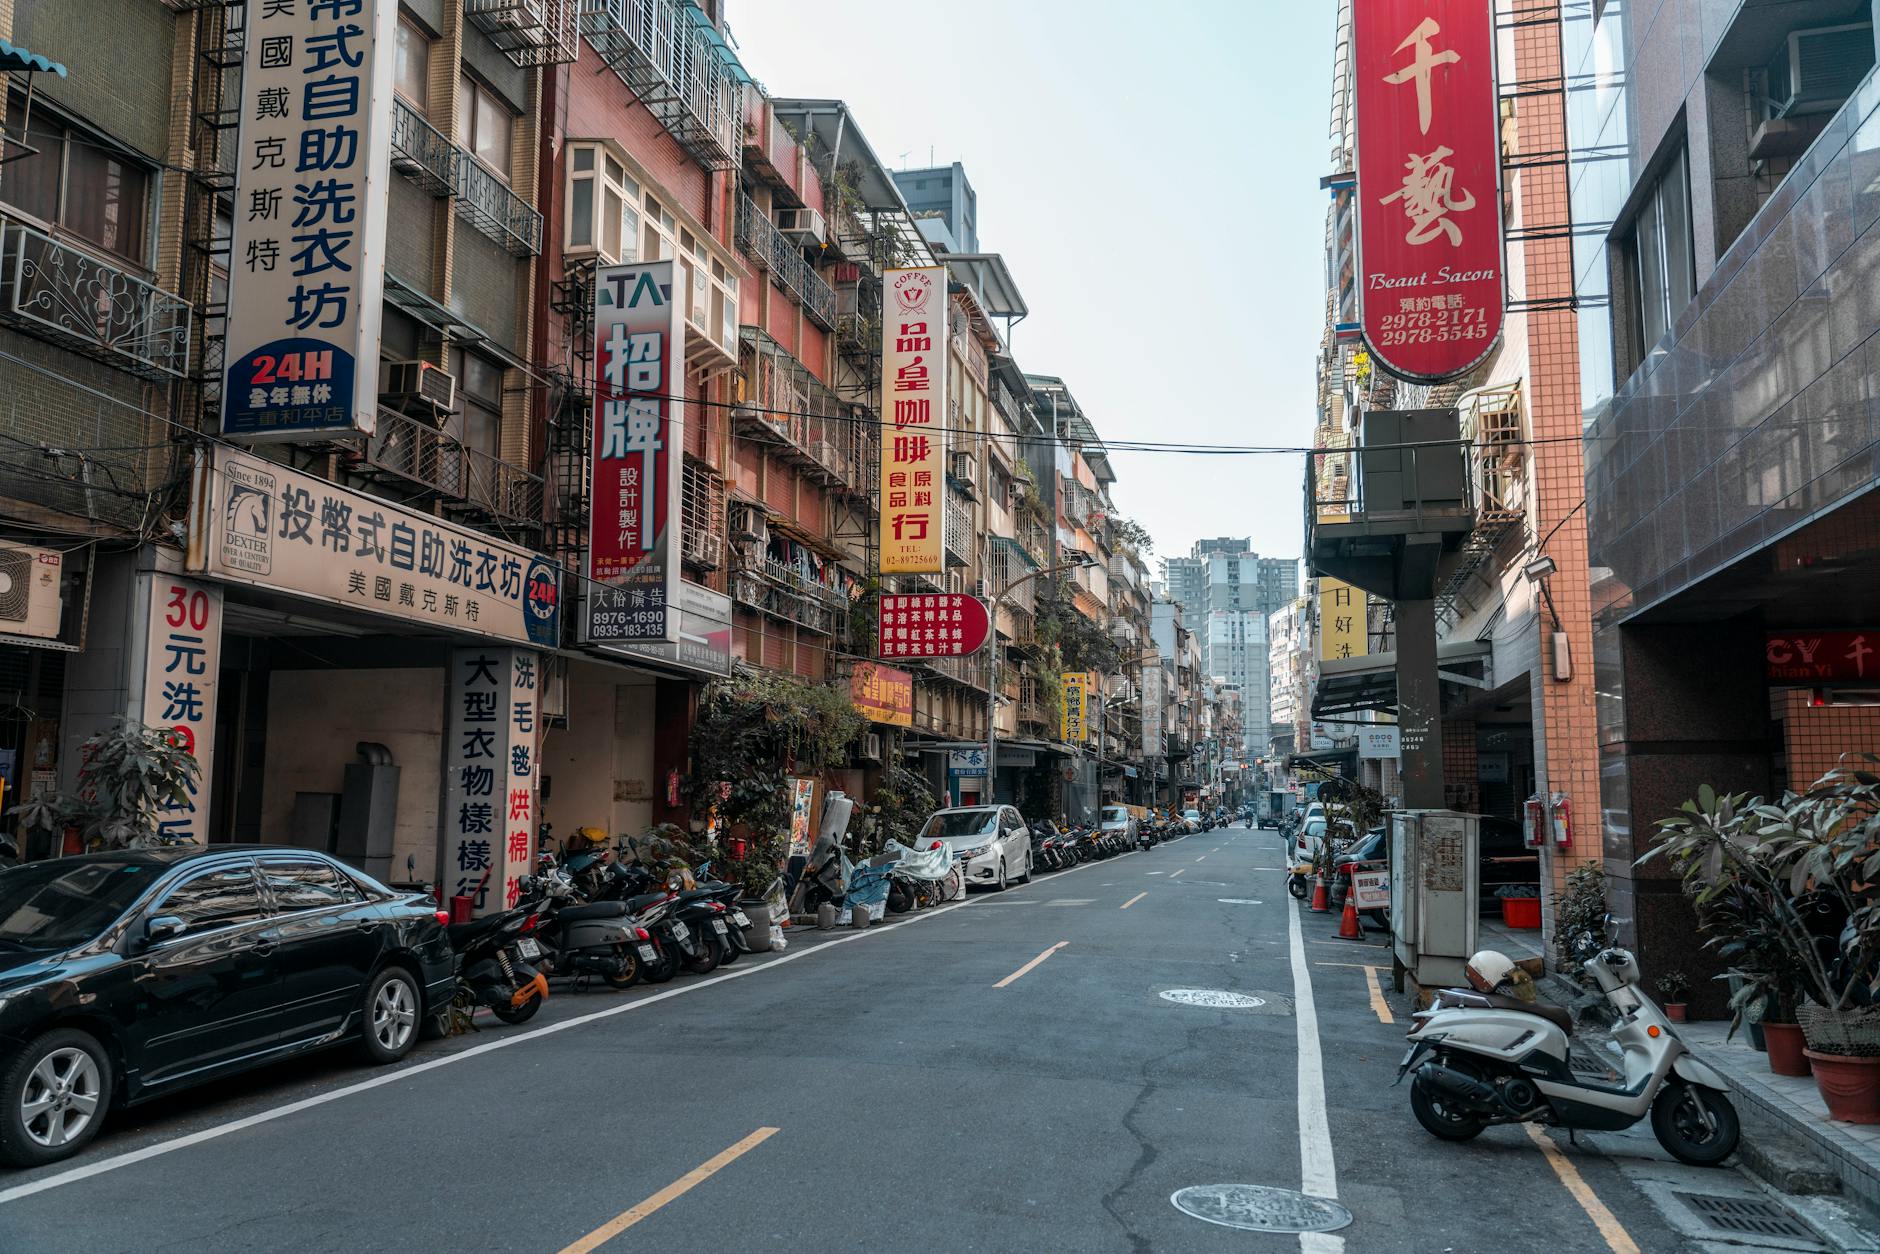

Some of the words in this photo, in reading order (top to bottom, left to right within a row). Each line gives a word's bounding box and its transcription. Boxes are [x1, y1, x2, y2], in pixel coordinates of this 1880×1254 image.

[1379, 16, 1476, 248] 千藝
[894, 272, 932, 290] COFFEE
[1369, 272, 1428, 290] Beaut
[1431, 265, 1495, 285] Sacon
[1380, 307, 1486, 330] 2978-2171
[1381, 323, 1488, 346] 2978-5545
[250, 350, 333, 385] 24H
[248, 383, 332, 409] 全年無休
[893, 321, 932, 466] 品皇咖啡
[234, 406, 345, 428] 三重和平店
[601, 322, 663, 551] 招牌
[227, 464, 253, 483] Since
[254, 474, 274, 490] 1894
[889, 472, 907, 508] 食品
[913, 471, 932, 507] 原料
[617, 467, 638, 549] 設計製作
[891, 514, 929, 541] 行
[222, 545, 238, 557] OVER
[244, 550, 270, 564] CENTURY
[225, 532, 267, 554] DEXTER
[278, 483, 522, 600] 投幣式自助洗衣坊
[238, 558, 263, 572] QUALITY
[347, 569, 480, 622] 美國戴克斯特
[528, 579, 557, 606] 24H
[593, 587, 665, 608] 大裕廣告
[592, 610, 664, 624] 8976-1690
[592, 623, 663, 637] 0935-183-135
[1844, 635, 1873, 678] 千
[1767, 664, 1810, 678] hian
[455, 655, 499, 909] 大型衣物樣樣行
